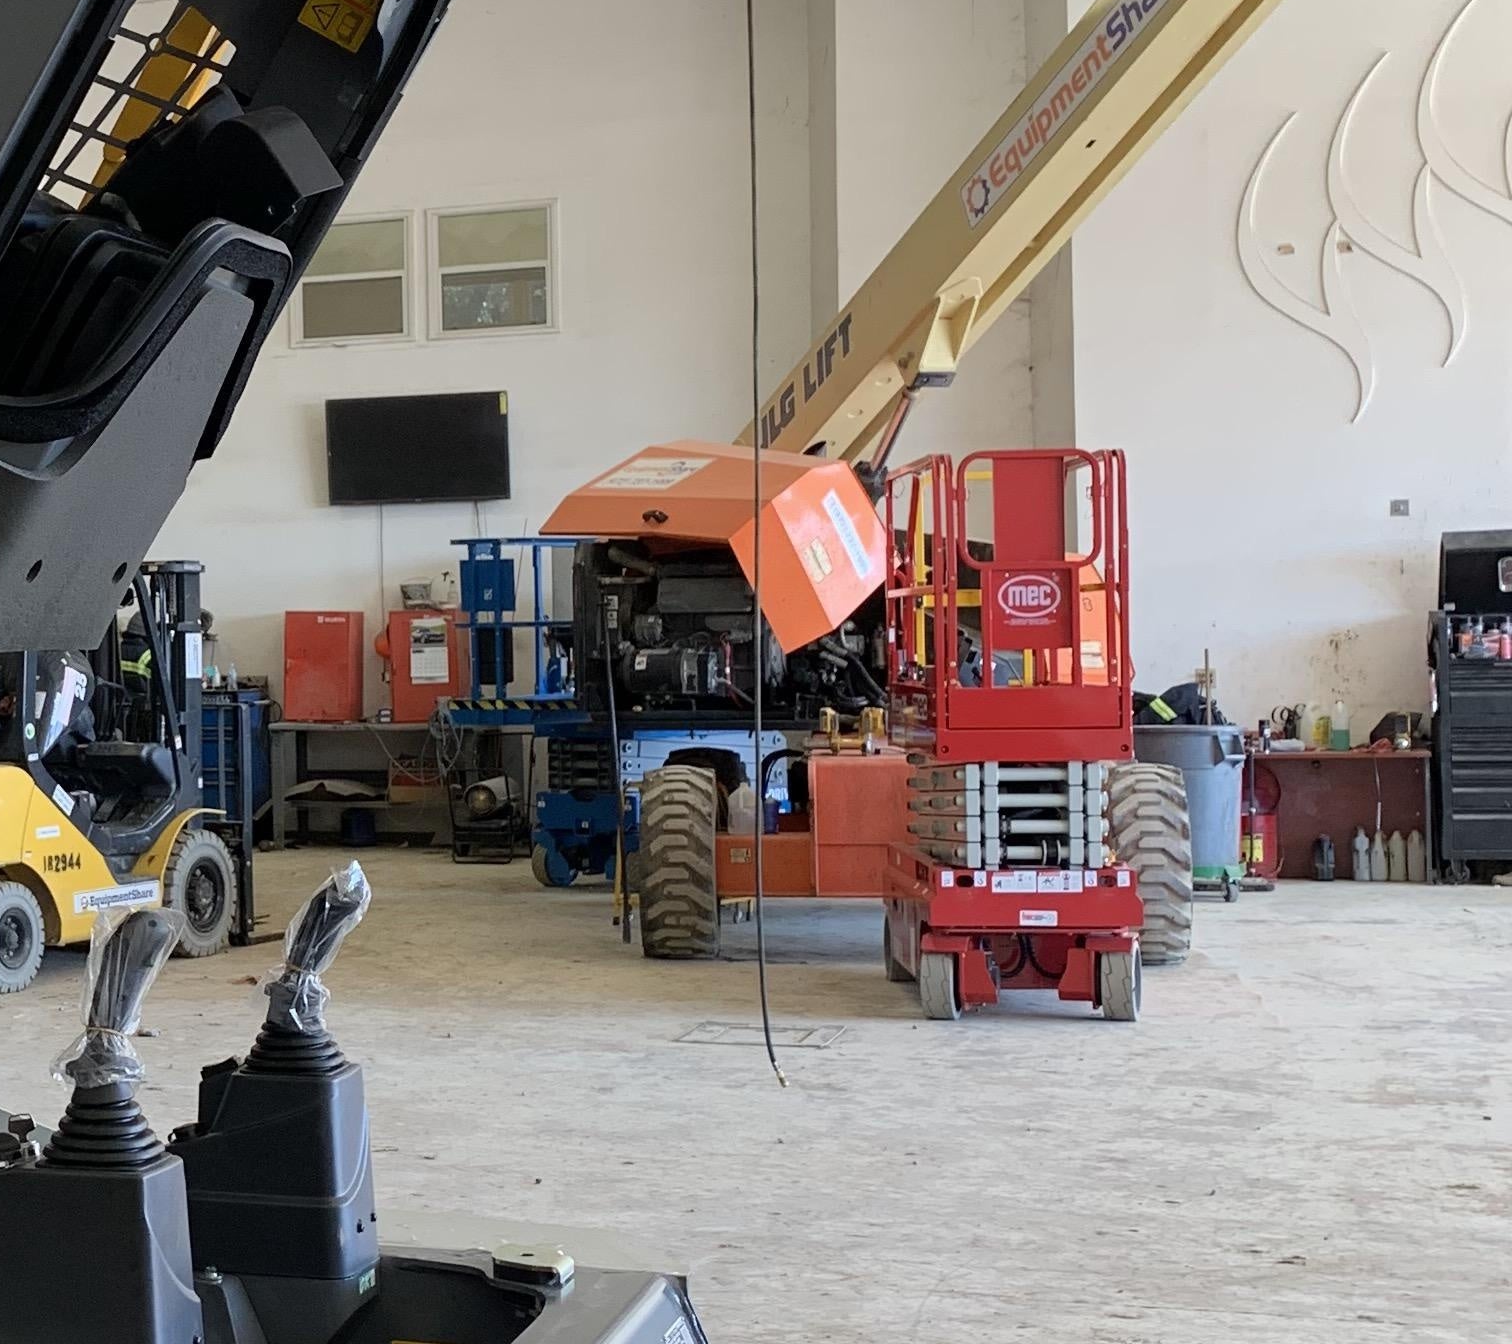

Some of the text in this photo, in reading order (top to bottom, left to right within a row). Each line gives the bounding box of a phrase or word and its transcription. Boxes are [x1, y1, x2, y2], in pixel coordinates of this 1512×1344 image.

[759, 311, 853, 450] JLG LIFT
[89, 888, 155, 908] EquipmentShare
